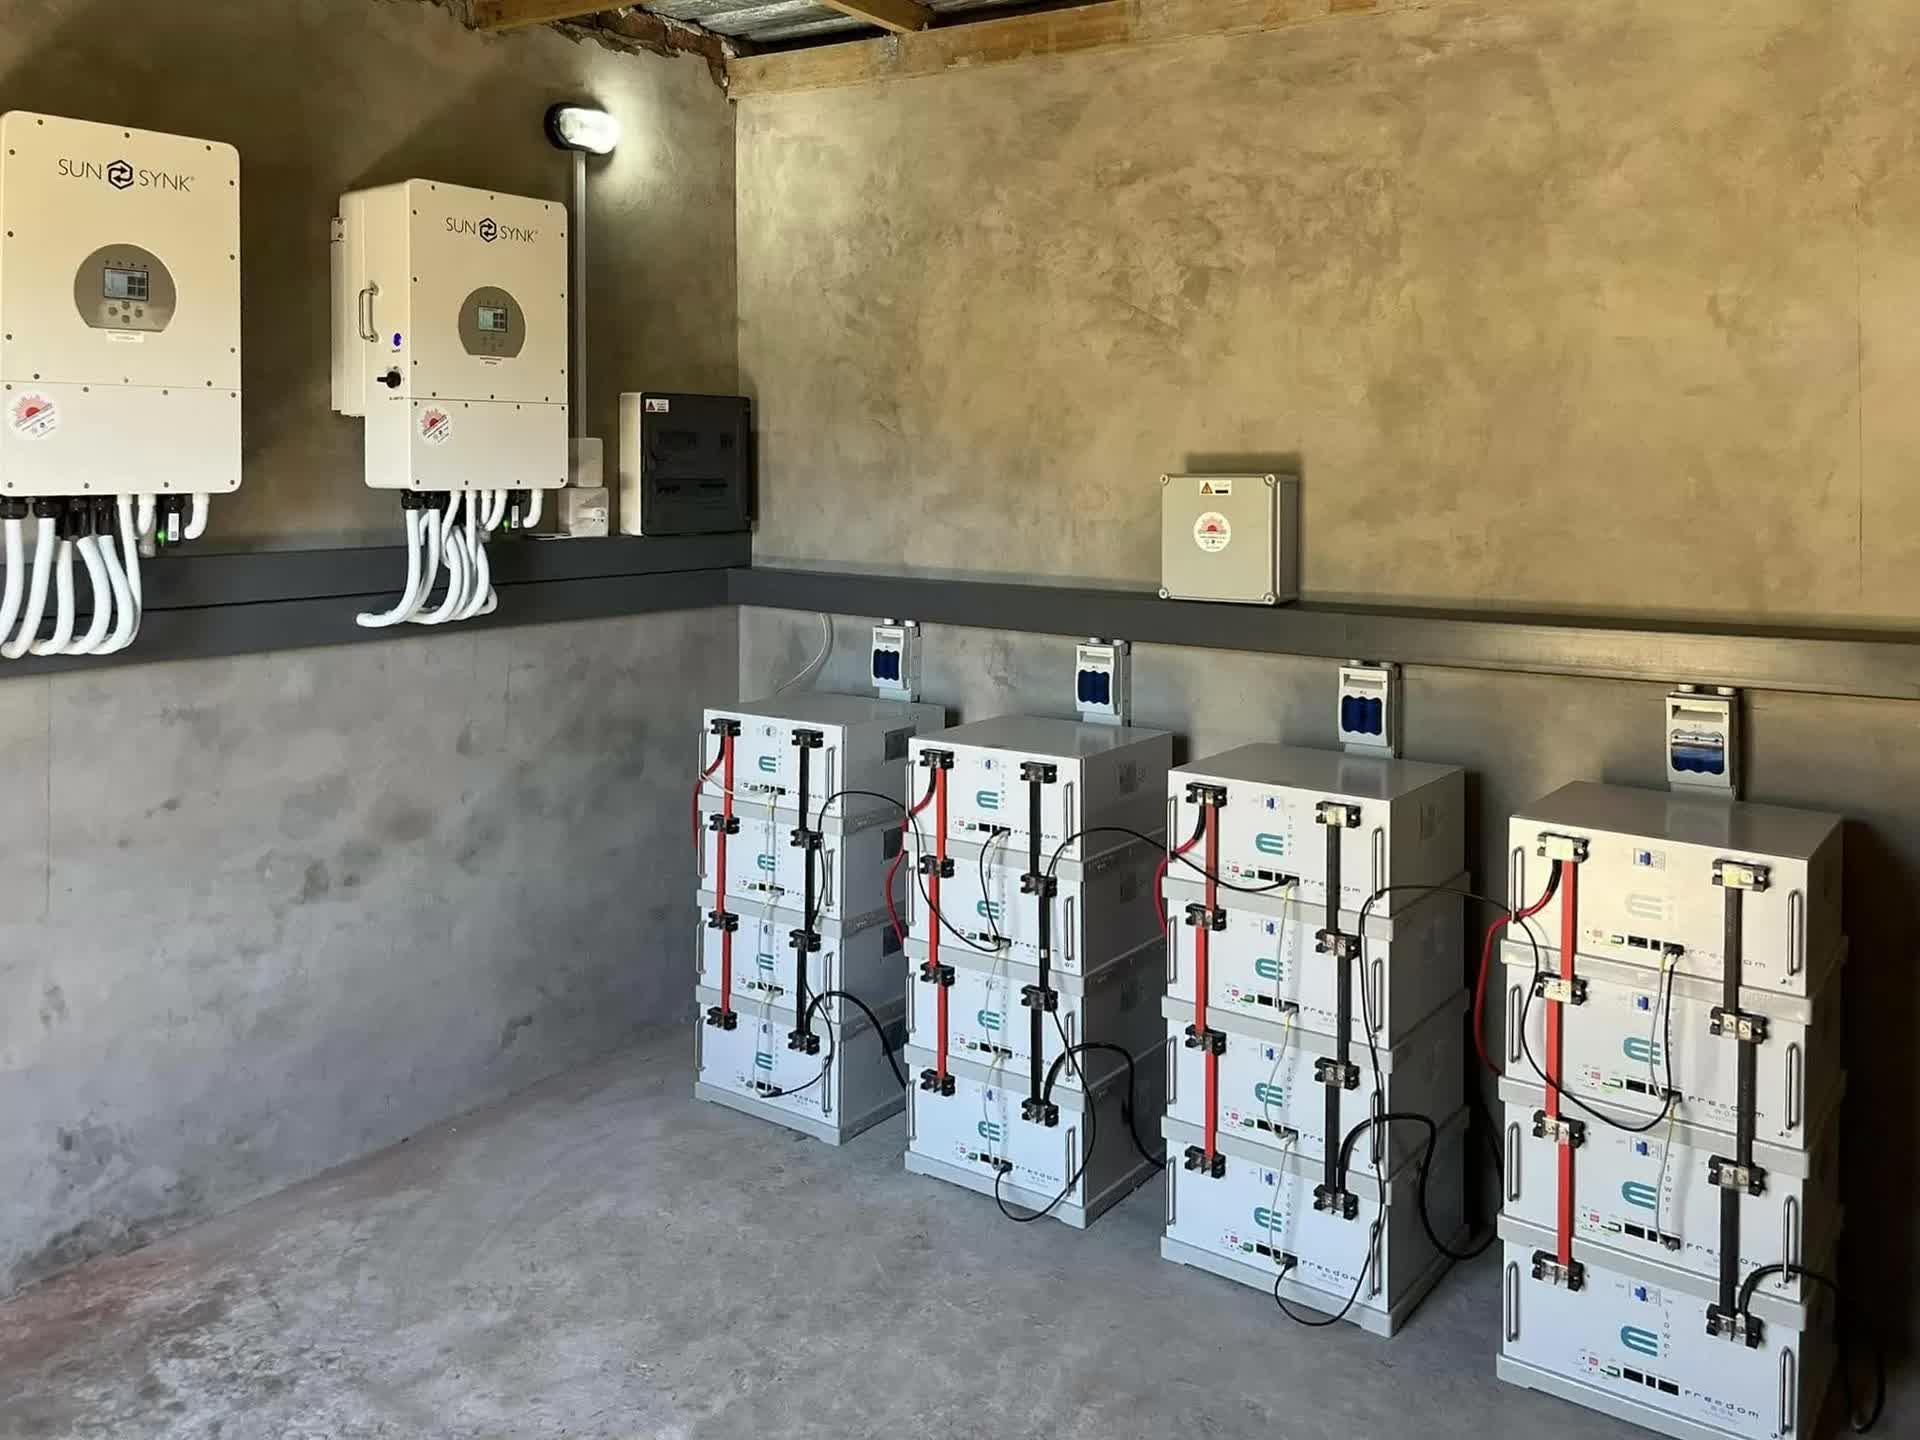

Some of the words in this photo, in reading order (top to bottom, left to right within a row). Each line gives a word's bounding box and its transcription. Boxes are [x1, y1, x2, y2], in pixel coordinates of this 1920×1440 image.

[58, 158, 102, 180] SUN
[139, 169, 191, 192] SYNK
[446, 217, 476, 235] SUN
[500, 225, 535, 243] SYNK
